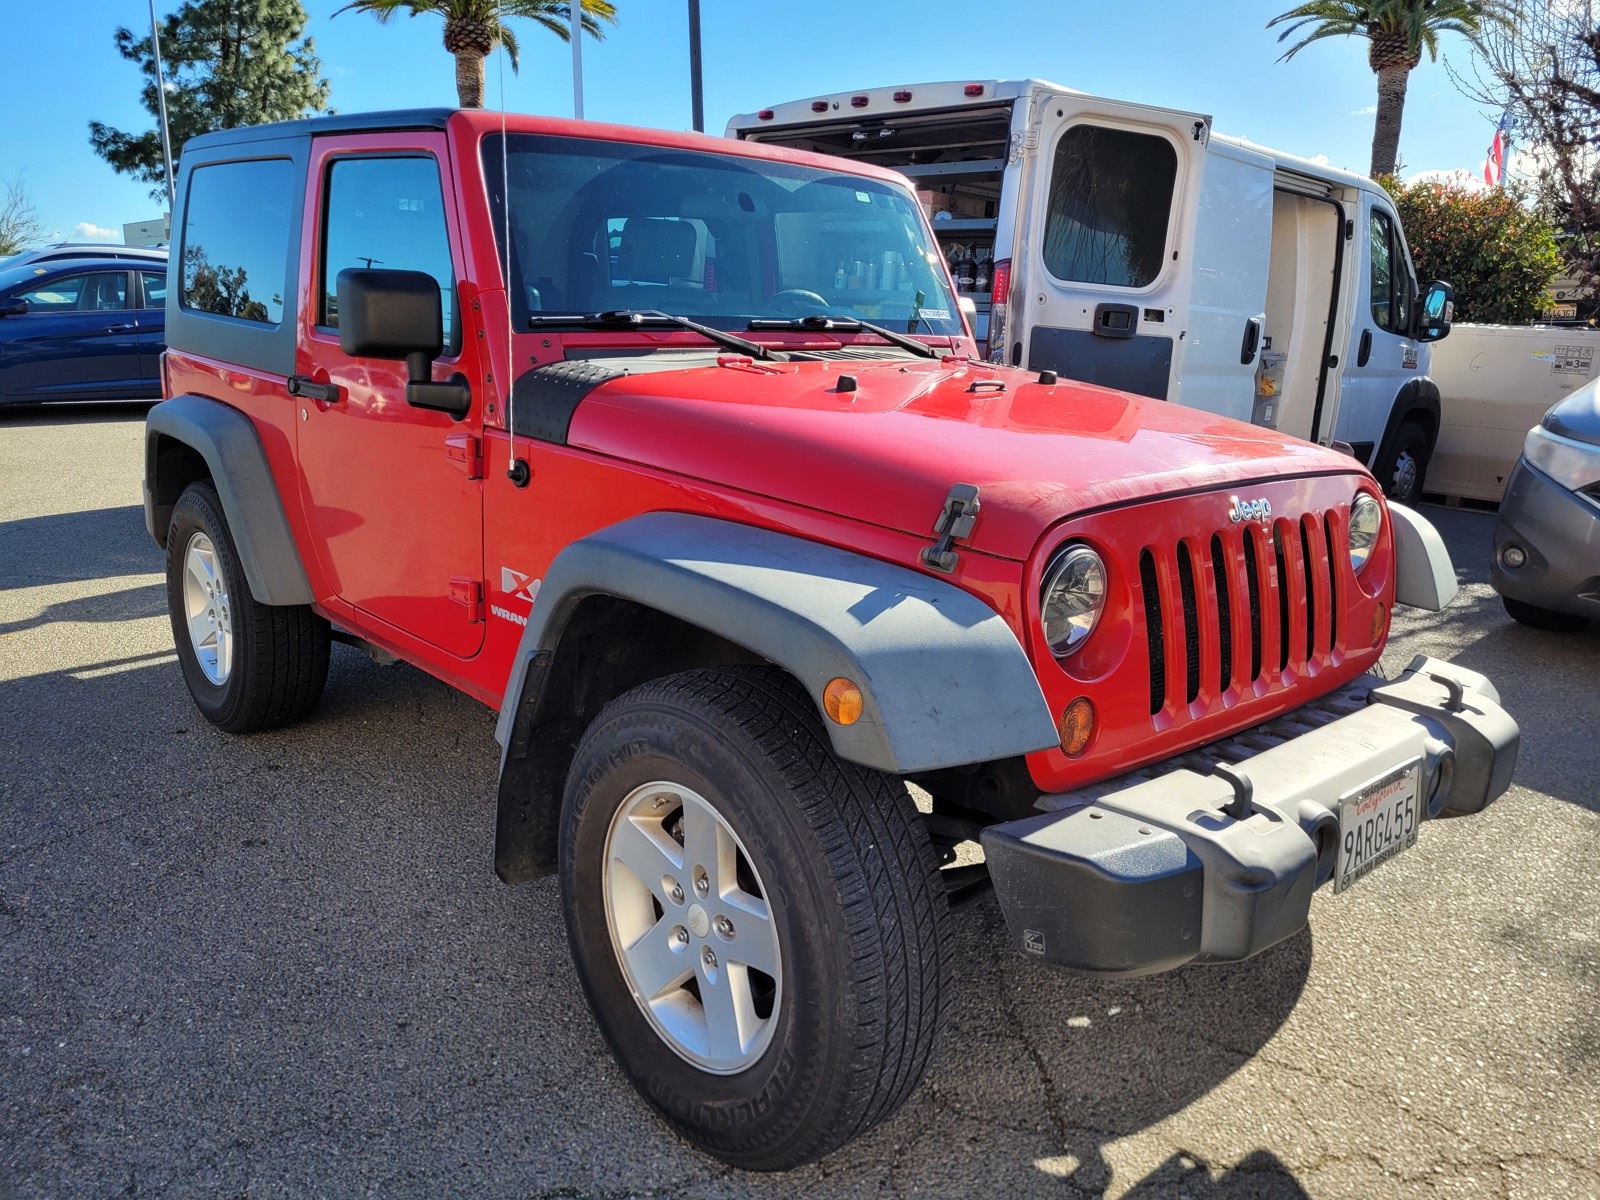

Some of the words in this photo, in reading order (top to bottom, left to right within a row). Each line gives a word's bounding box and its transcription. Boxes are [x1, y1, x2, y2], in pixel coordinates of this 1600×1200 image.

[1573, 360, 1580, 368] 3
[1229, 495, 1271, 523] Jeep
[1356, 781, 1407, 816] California
[1344, 794, 1414, 874] 9ARG455
[1355, 861, 1373, 878] MAZDA
[1374, 842, 1402, 864] ROSEVILLE
